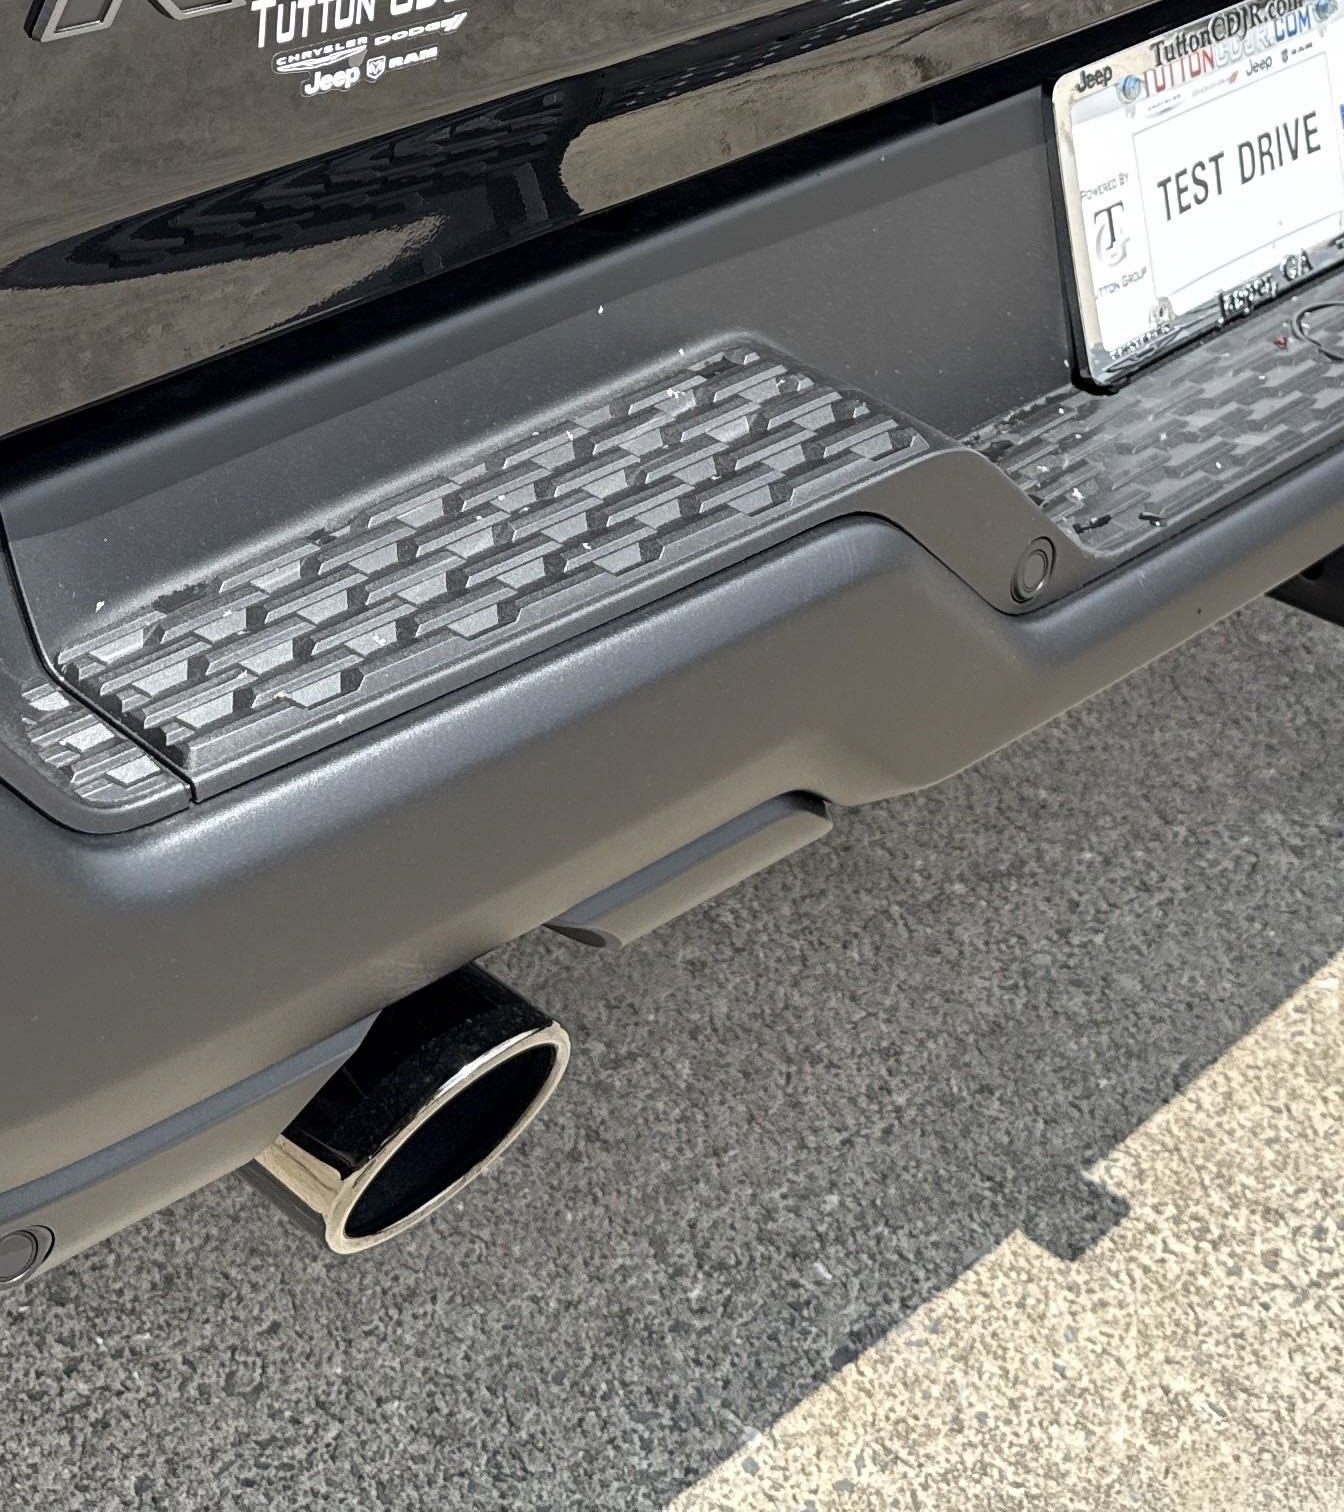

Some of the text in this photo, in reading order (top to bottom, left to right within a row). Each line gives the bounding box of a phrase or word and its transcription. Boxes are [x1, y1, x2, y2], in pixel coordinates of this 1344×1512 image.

[276, 36, 368, 66] CHRYSLER
[1246, 55, 1273, 76] Jeep
[305, 46, 438, 95] Jeep RAM
[1074, 65, 1113, 94] Jeep
[1119, 172, 1130, 187] BY
[1157, 110, 1321, 222] TEST DRIVE
[1280, 248, 1314, 282] GA
